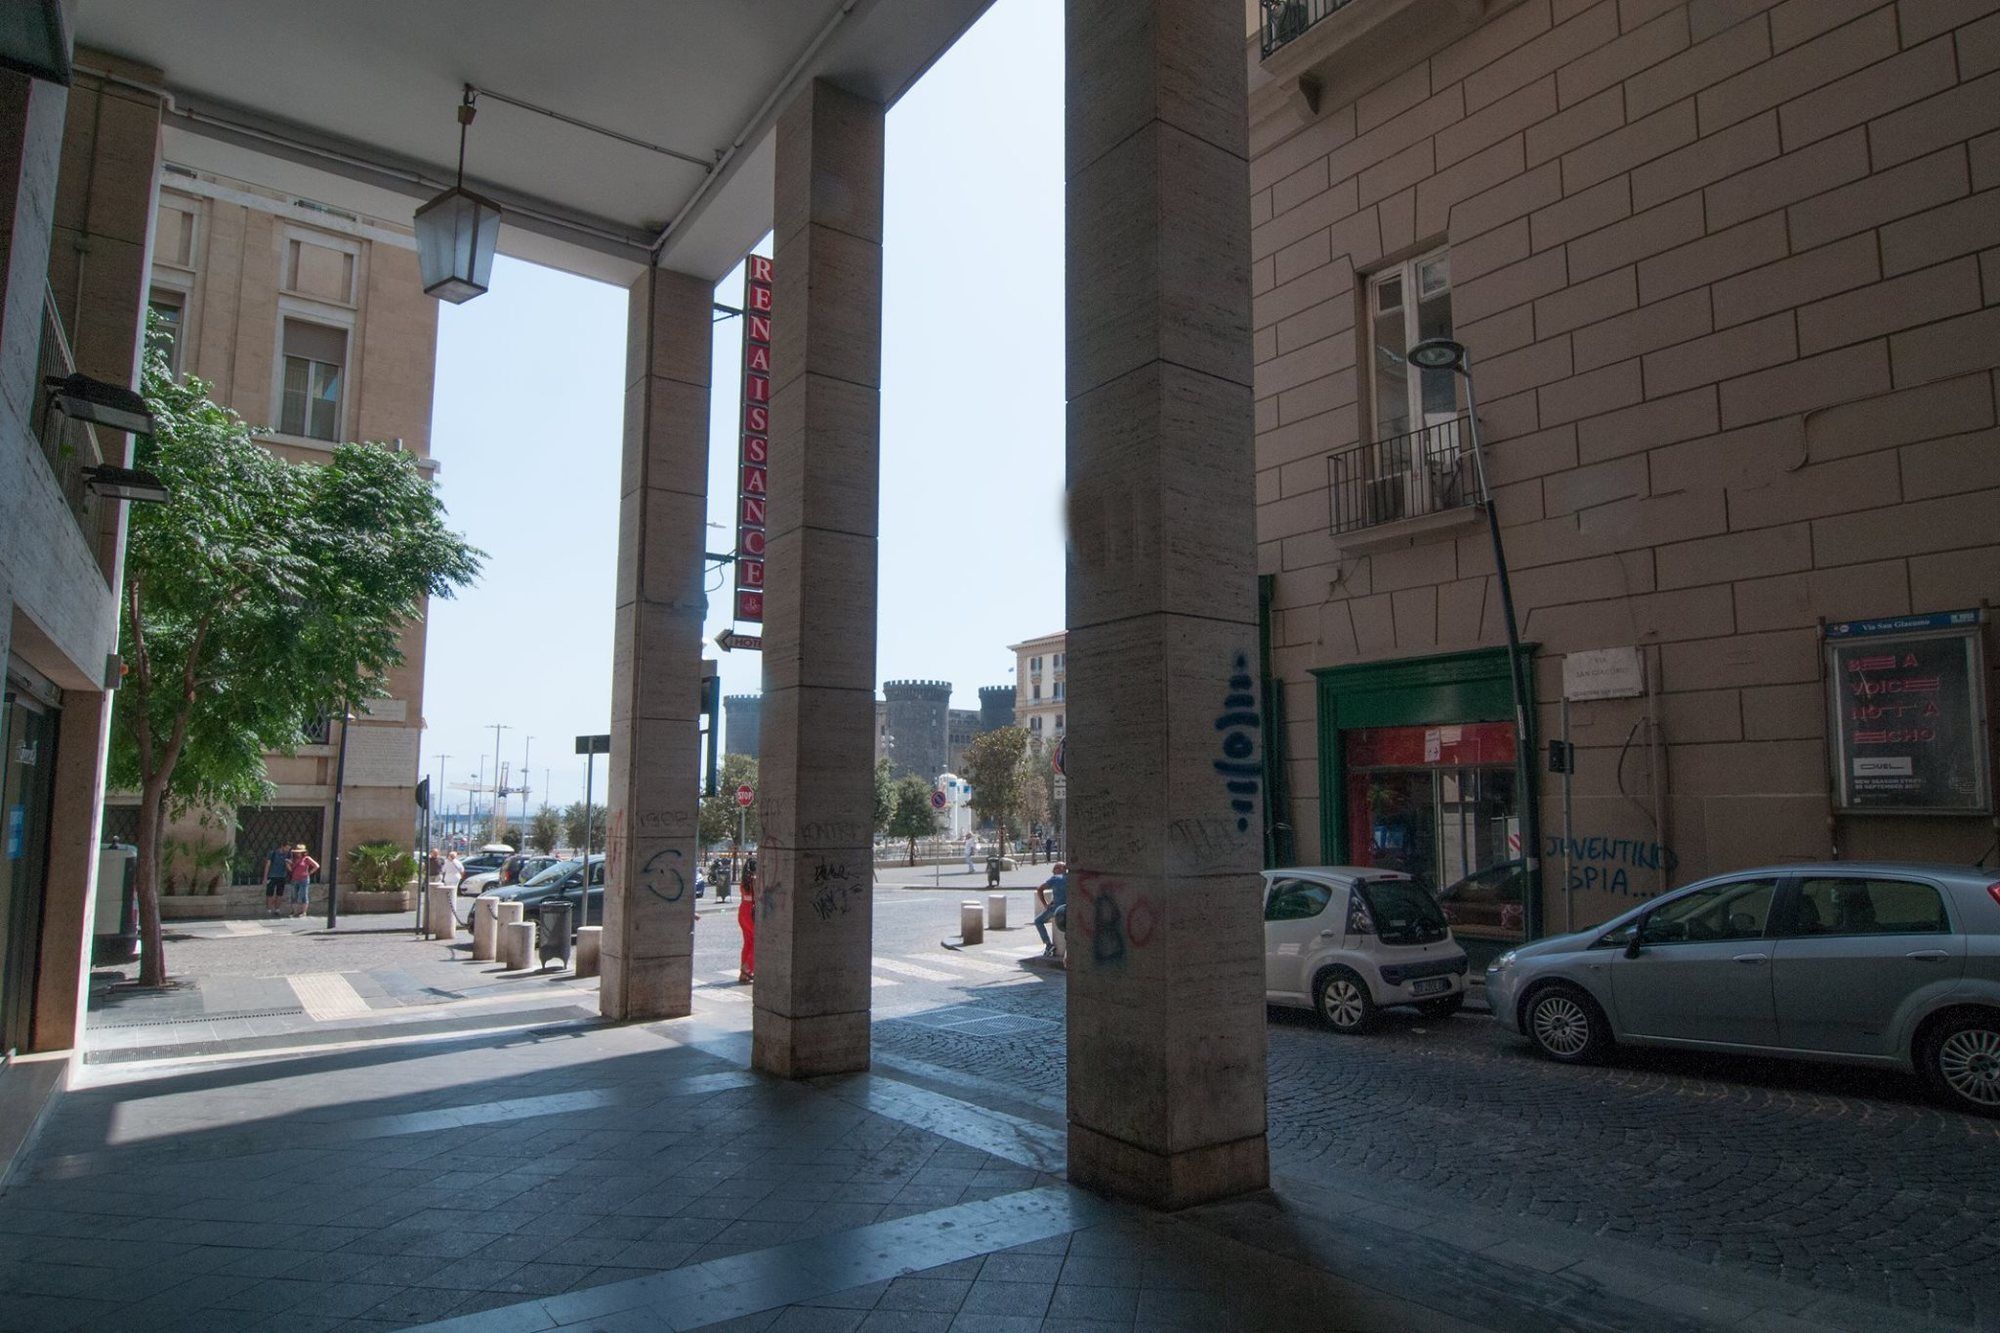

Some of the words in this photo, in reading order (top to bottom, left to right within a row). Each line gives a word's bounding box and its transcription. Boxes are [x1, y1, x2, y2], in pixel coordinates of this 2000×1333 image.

[745, 255, 772, 586] RENAISSANCE
[1862, 623, 1876, 631] Via
[1877, 622, 1893, 630] San
[1894, 619, 1931, 628] Giacomo
[737, 791, 754, 800] STOP
